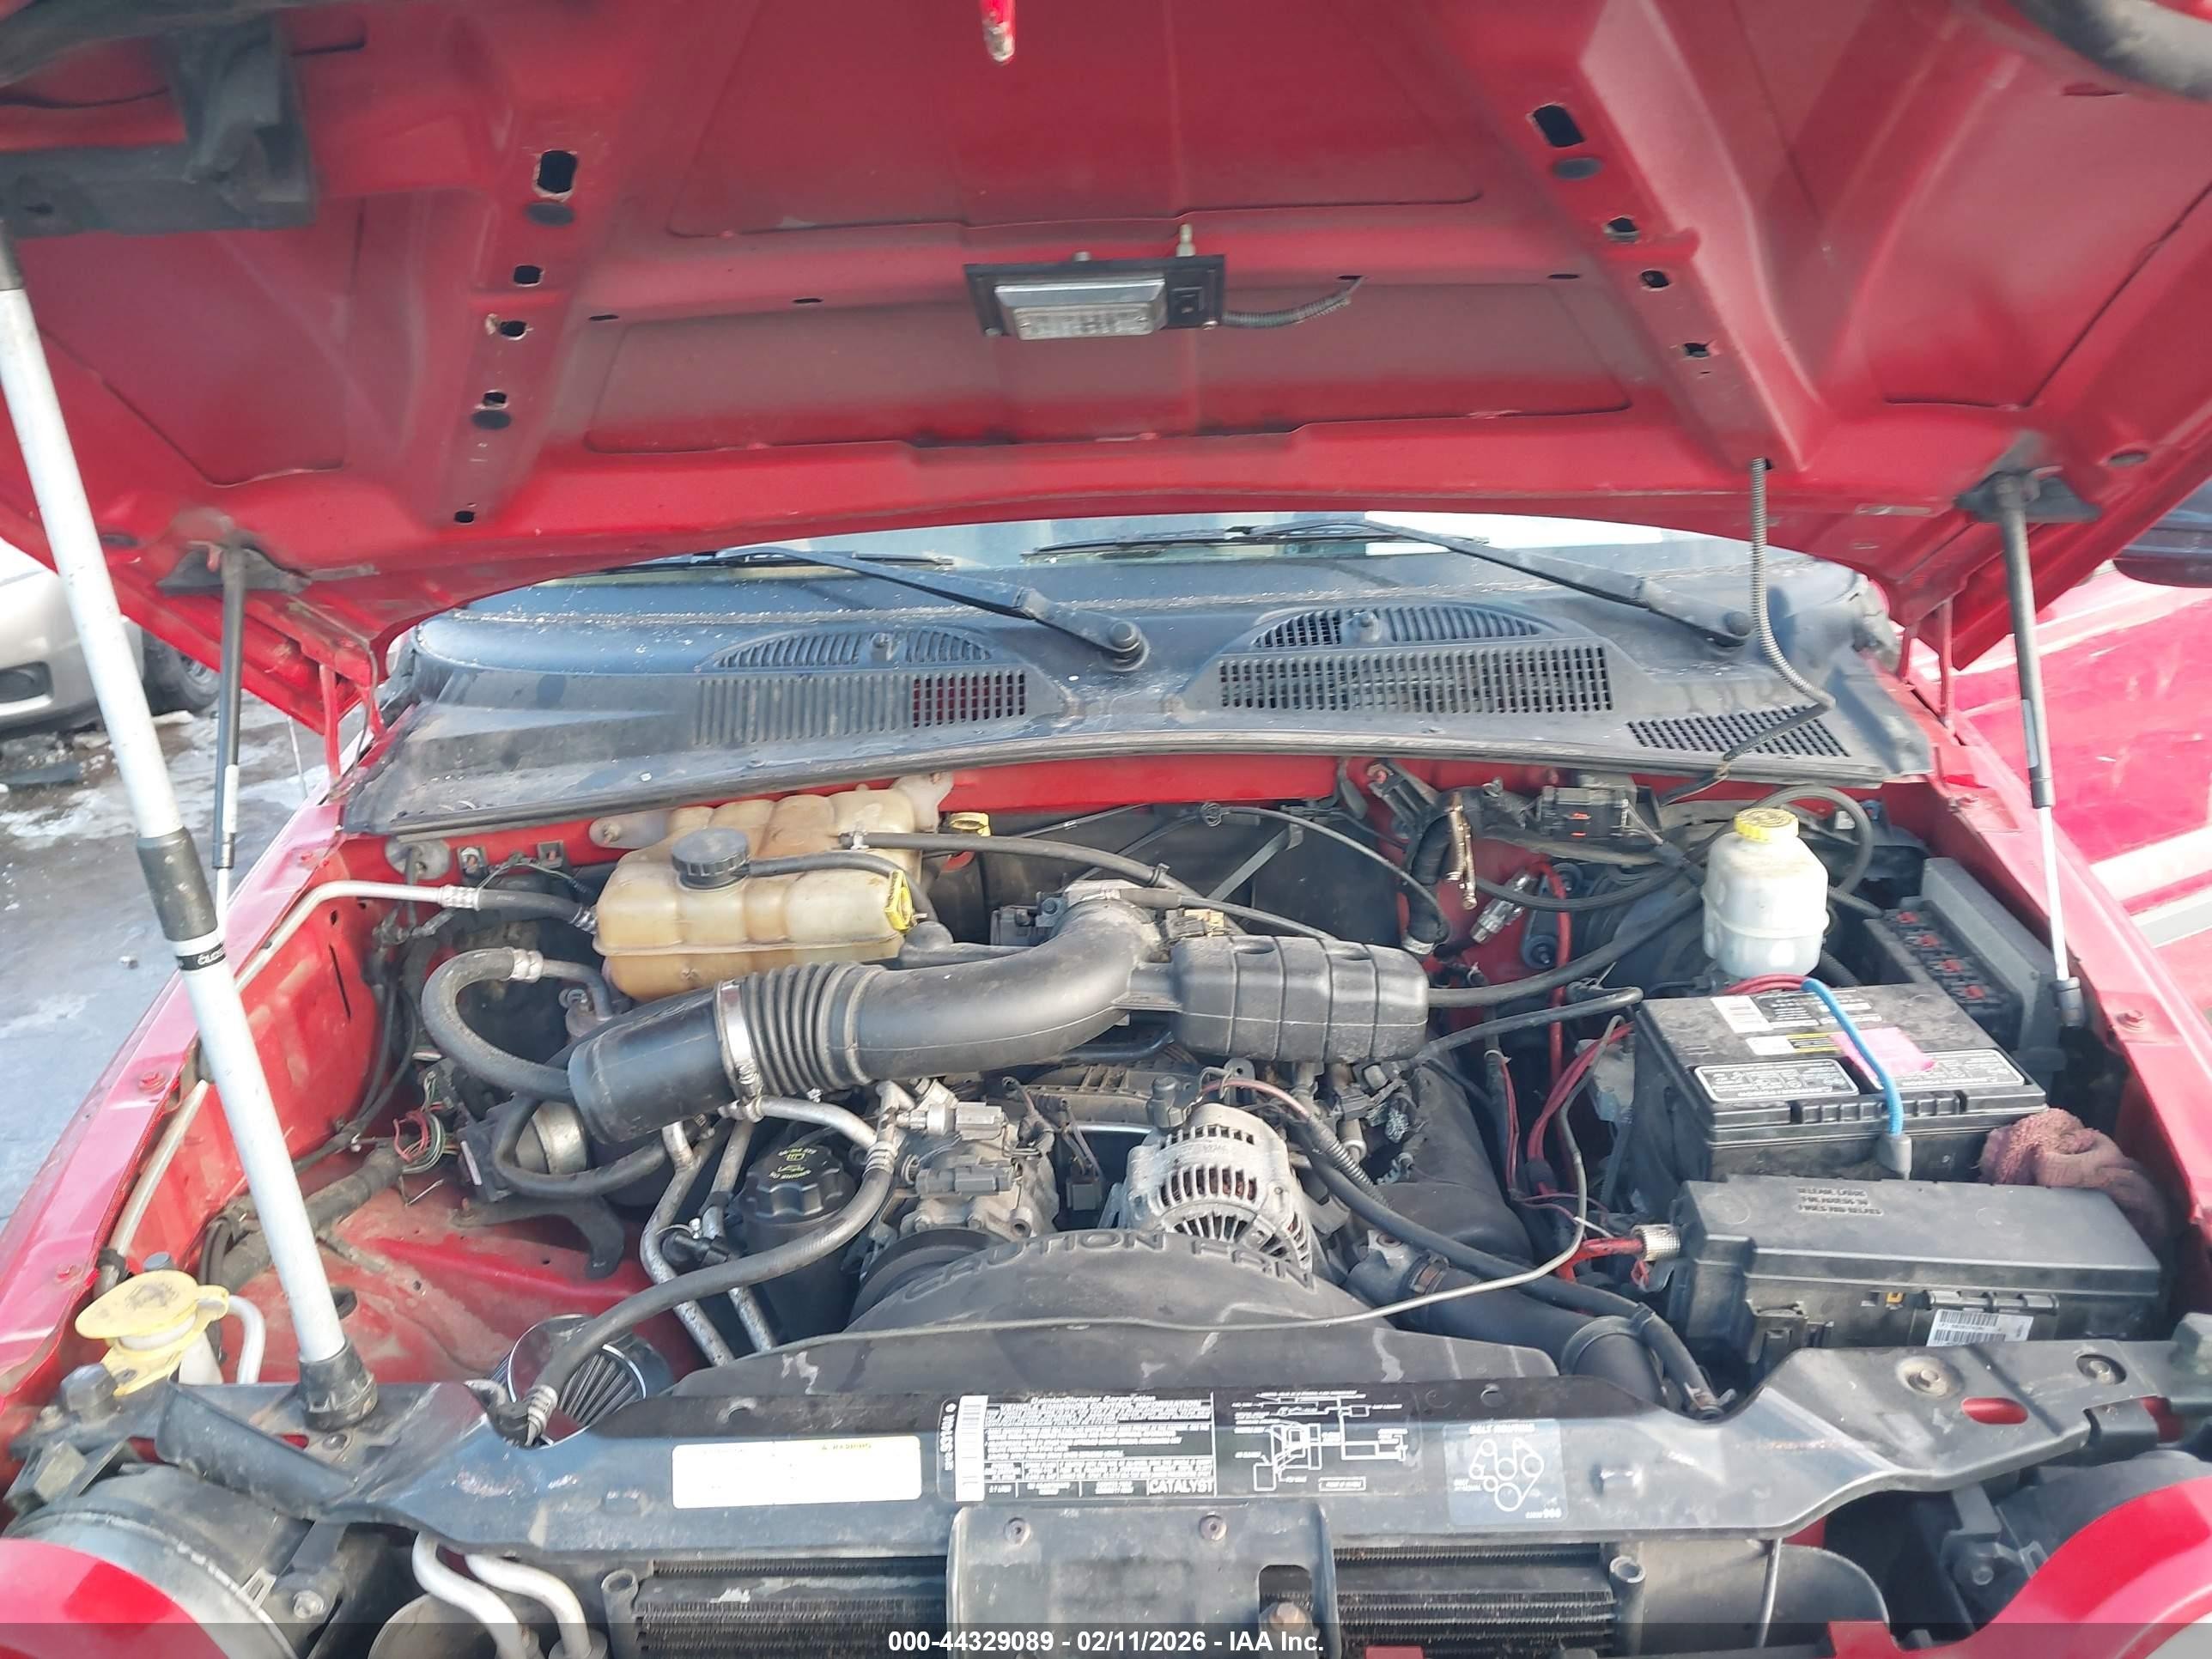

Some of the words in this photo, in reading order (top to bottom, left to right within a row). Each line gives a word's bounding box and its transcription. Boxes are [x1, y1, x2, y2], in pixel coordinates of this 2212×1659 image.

[903, 1231, 1167, 1302] CAUTION
[1191, 1239, 1318, 1294] FAN
[1149, 1480, 1214, 1494] CATALYST
